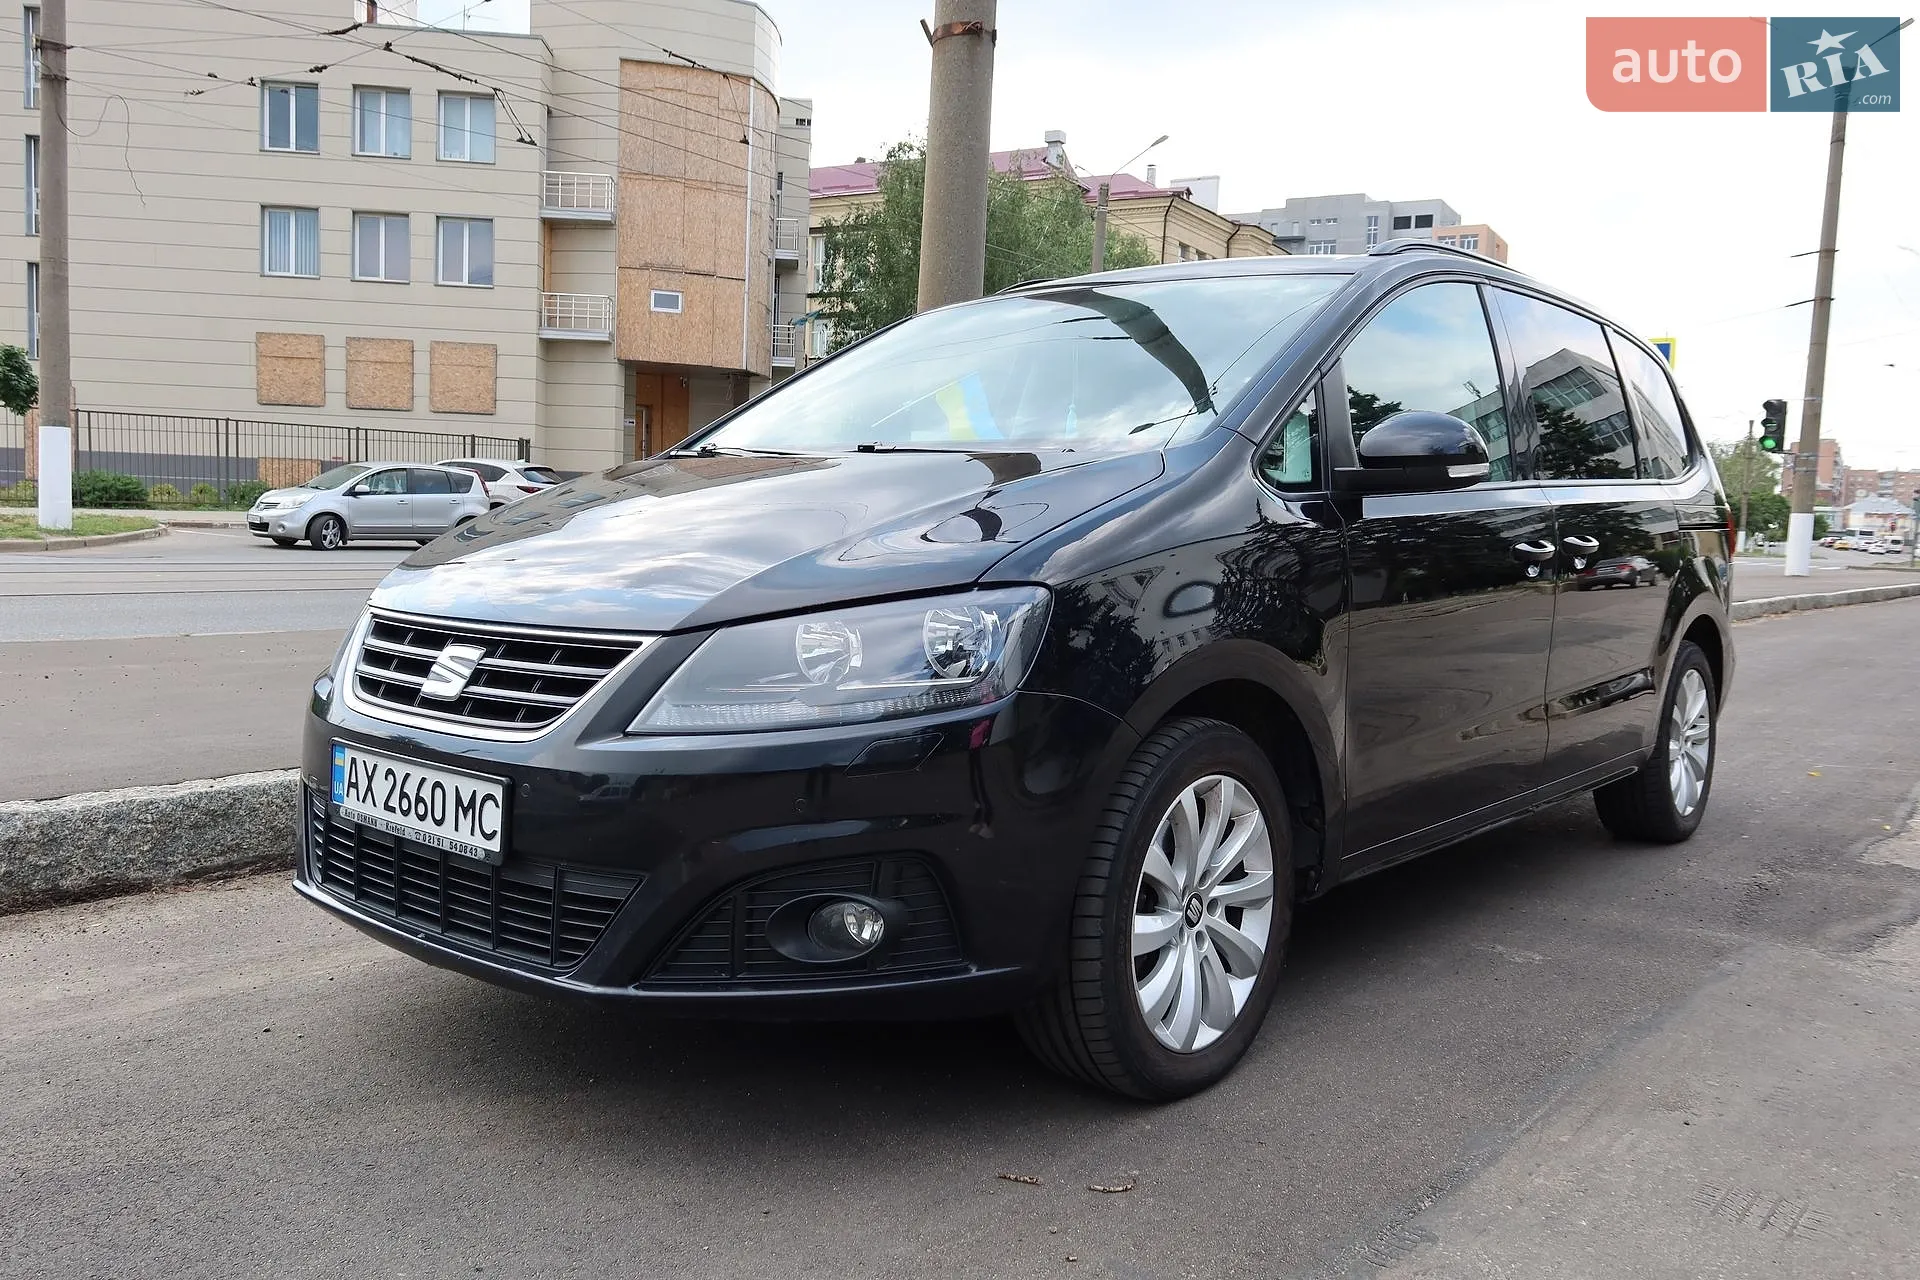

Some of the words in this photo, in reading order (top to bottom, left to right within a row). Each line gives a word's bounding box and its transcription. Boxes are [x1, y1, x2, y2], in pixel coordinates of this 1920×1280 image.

[334, 781, 344, 796] UA
[345, 756, 379, 808] AX
[383, 767, 447, 827] 2660
[454, 784, 501, 841] MC
